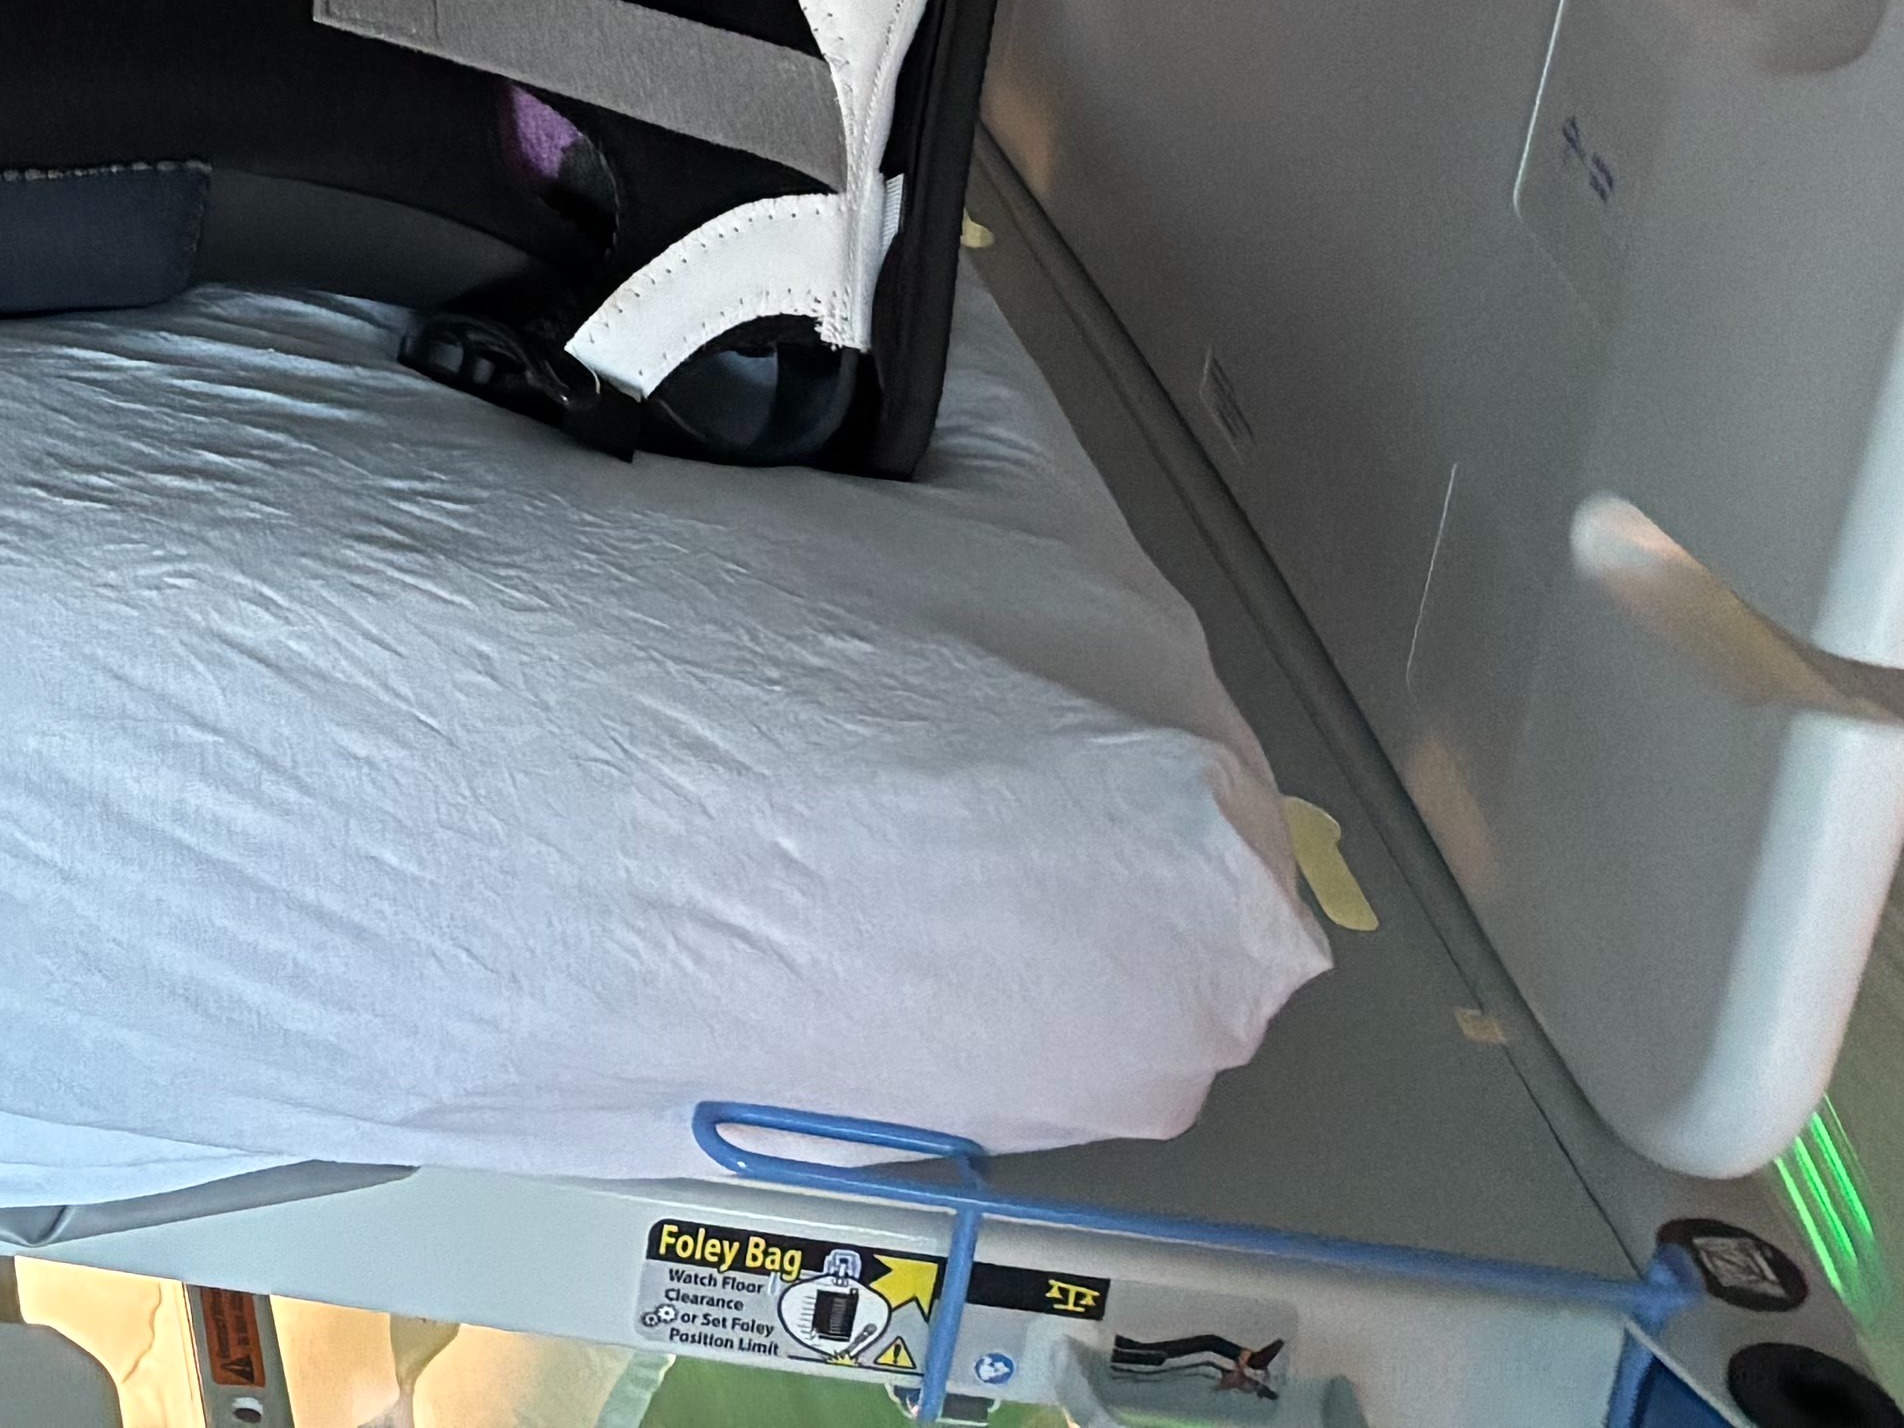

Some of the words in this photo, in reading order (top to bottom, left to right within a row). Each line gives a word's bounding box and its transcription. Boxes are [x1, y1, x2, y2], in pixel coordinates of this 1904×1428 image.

[658, 1224, 741, 1272] Foley
[745, 1235, 803, 1282] Bag
[668, 1268, 718, 1288] Watch
[721, 1275, 765, 1295] Floor
[664, 1287, 745, 1312] Clearance
[680, 1312, 699, 1324] or
[700, 1312, 727, 1330] Set
[731, 1317, 776, 1338] Foley
[668, 1327, 735, 1350] Position
[737, 1336, 780, 1357] Limit
